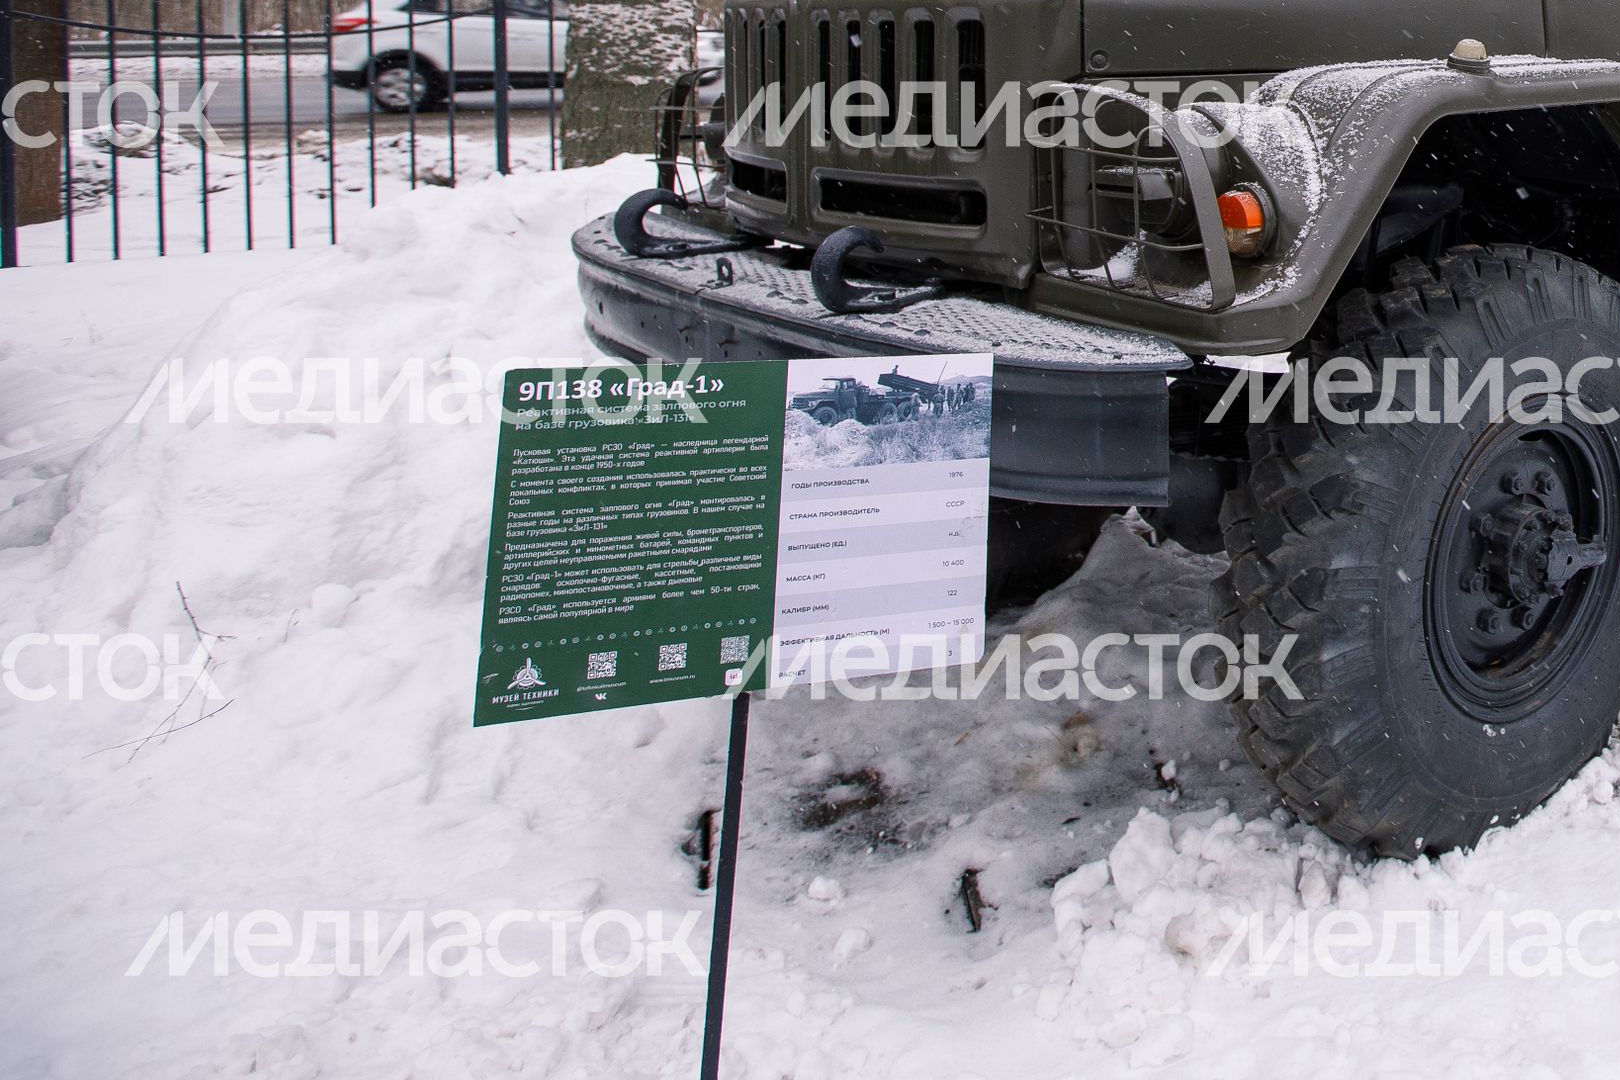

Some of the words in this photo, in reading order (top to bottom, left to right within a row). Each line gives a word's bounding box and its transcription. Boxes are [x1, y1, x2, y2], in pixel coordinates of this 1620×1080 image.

[518, 378, 603, 401] 9П138
[609, 374, 725, 401] «Град-1»
[516, 405, 594, 418] Реактивная
[597, 404, 649, 413] система
[652, 401, 716, 412] залпового
[719, 398, 746, 407] огня
[515, 422, 531, 430] на
[534, 419, 564, 429] базе
[568, 417, 634, 430] грузовика
[513, 447, 550, 458] Пусковая
[556, 446, 596, 455] установка
[602, 443, 622, 451] РСЗО
[628, 441, 654, 451] «Град»
[673, 439, 717, 448] наследница
[723, 434, 768, 445] легендарной
[561, 454, 575, 462] Эта
[581, 454, 613, 462] удачная
[654, 447, 697, 457] реактивной
[702, 446, 744, 454] артиллерии
[512, 464, 562, 475] разработана
[596, 460, 620, 468] 1950-х
[509, 488, 553, 498] локальных
[558, 484, 606, 494] конфликтах,
[620, 481, 650, 490] которых
[655, 479, 692, 487] принимал
[696, 476, 725, 485] участие
[729, 472, 766, 481] Советский
[519, 479, 553, 487] момента
[586, 475, 623, 483] создания
[626, 470, 686, 480] использовалась
[689, 467, 735, 477] практически
[813, 478, 869, 487] ПРОИЗВОДСТВА
[507, 508, 555, 519] Реактивная
[561, 507, 593, 515] система
[600, 504, 639, 512] залпового
[668, 498, 694, 508] «Град»
[700, 495, 755, 506] монтировалась
[509, 497, 529, 505] Союз
[506, 520, 536, 530] разные
[540, 518, 559, 526] годы
[576, 514, 617, 525] различных
[728, 504, 752, 512] случае
[789, 512, 817, 520] СТРАНА
[819, 507, 879, 517] ПРОИЗВОДИТЕЛЬ
[506, 529, 525, 537] базе
[526, 527, 566, 536] грузовика
[503, 547, 569, 562] артиллерийских
[586, 543, 634, 552] минометных
[677, 536, 718, 546] командных
[724, 531, 753, 542] пунктов
[504, 538, 567, 553] Предназначена
[589, 534, 632, 545] поражения
[635, 530, 659, 539] живой
[787, 542, 830, 551] ВЫПУЩЕНО
[503, 561, 531, 570] других
[533, 557, 558, 566] целей
[559, 552, 626, 565] неуправляемыми
[628, 549, 669, 558] ракетными
[671, 545, 711, 555] снарядами
[502, 574, 523, 583] РСЗО
[526, 570, 562, 582] «Град-1»
[591, 565, 644, 574] использовать
[646, 563, 660, 571] для
[702, 556, 740, 565] различные
[709, 562, 761, 573] постановщики
[667, 576, 702, 585] дымовые
[786, 574, 811, 582] МАССА
[812, 572, 825, 580] (КГ)
[499, 605, 521, 615] РЗСО
[527, 602, 556, 614] «Град»
[562, 597, 616, 610] используется
[622, 593, 655, 603] армиями
[662, 589, 684, 598] более
[710, 584, 731, 593] 50-ти
[498, 615, 531, 624] являясь
[533, 611, 557, 620] самой
[559, 606, 606, 619] популярной
[614, 605, 633, 613] мире
[781, 606, 811, 615] КАЛИБР
[812, 604, 829, 612] (ММ)
[879, 627, 889, 635] (М)
[931, 620, 945, 628] 500
[492, 692, 519, 704] МУЗЕЙ
[522, 688, 559, 700] ТЕХНИКИ
